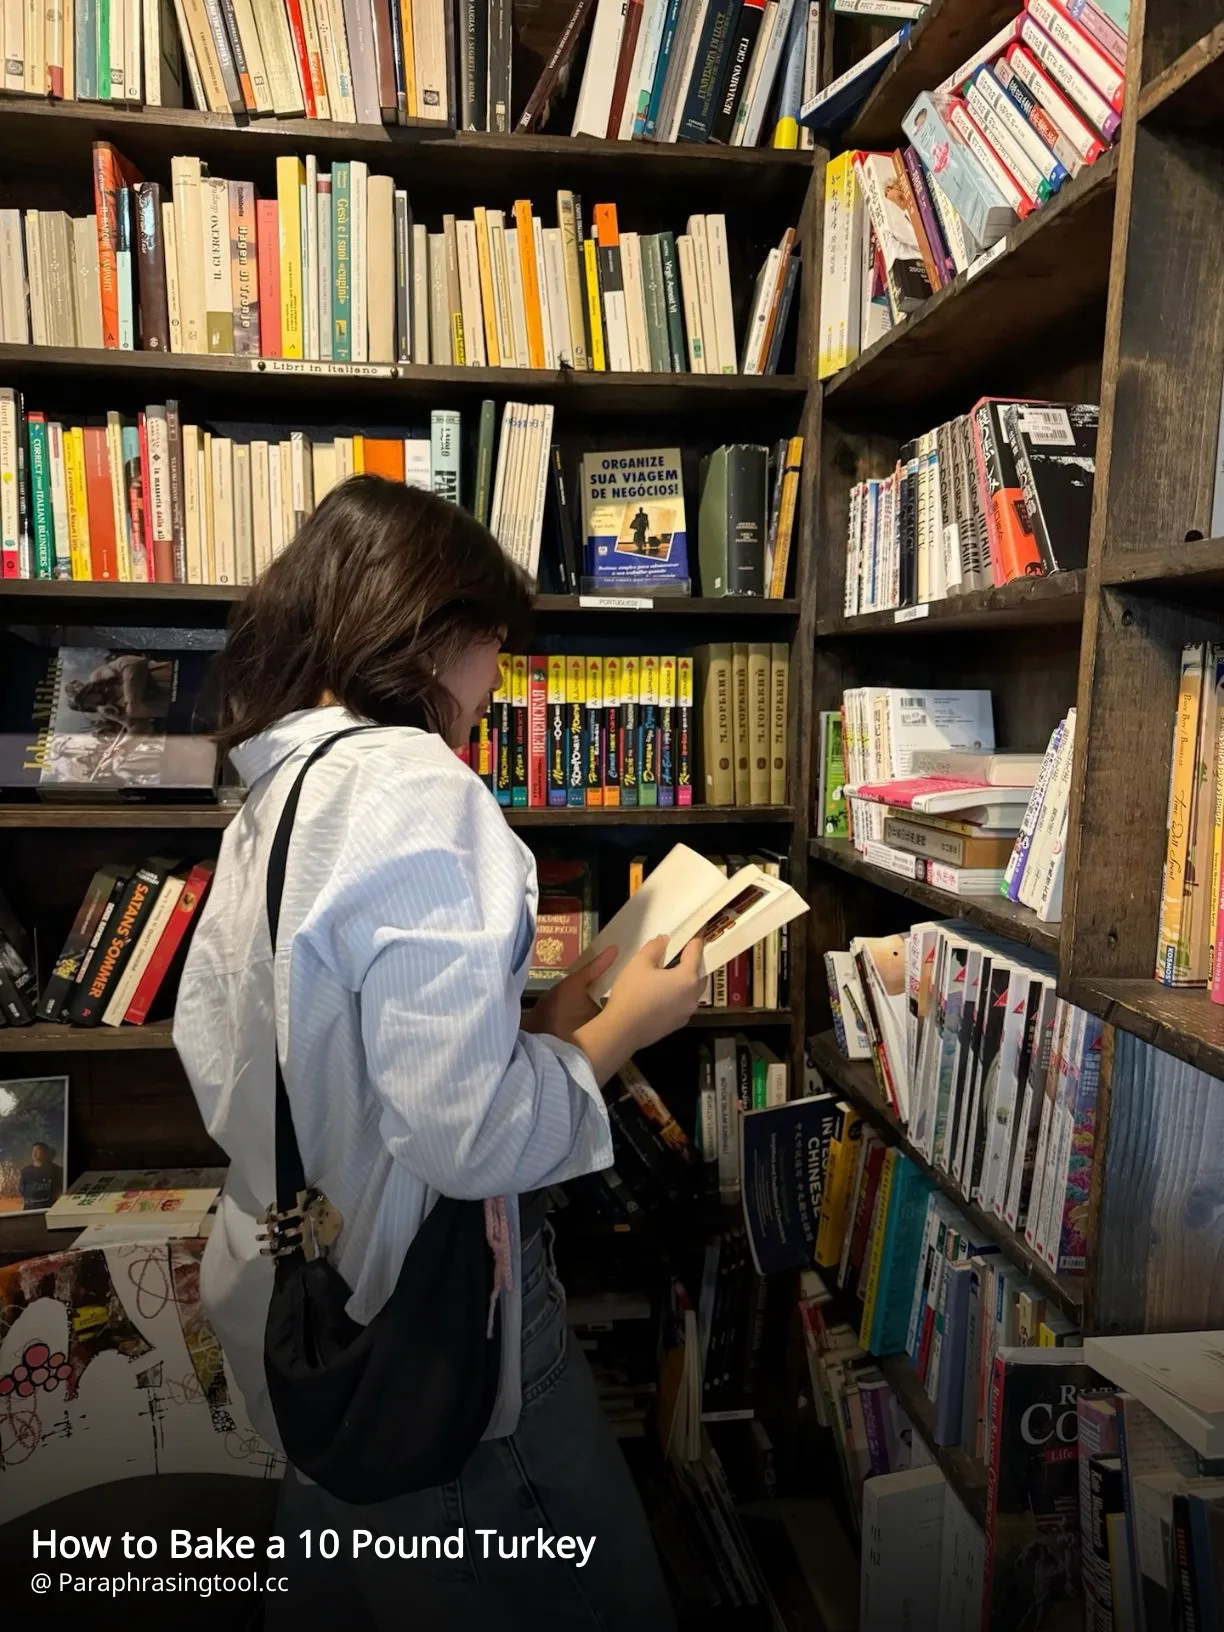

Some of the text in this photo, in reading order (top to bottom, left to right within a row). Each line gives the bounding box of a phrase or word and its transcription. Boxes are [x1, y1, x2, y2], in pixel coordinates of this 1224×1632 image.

[722, 36, 750, 116] BENIAMINO GIGLI
[336, 198, 349, 223] Gesù
[211, 215, 222, 266] GUERCINO
[237, 225, 248, 265] Hagen
[336, 240, 348, 261] suoi
[240, 285, 251, 329] Tronje
[273, 362, 304, 371] Libri
[309, 364, 322, 372] in
[1, 395, 12, 468] Fluent Forever
[33, 438, 43, 475] CORRECT
[601, 456, 664, 470] ORGANIZE
[590, 469, 678, 485] SUA VIAGEM
[591, 483, 678, 499] DE NEGÓCIOS!
[35, 490, 45, 523] ITALIAN
[38, 524, 48, 568] BLUNDERS
[1168, 849, 1182, 881] Spent
[116, 882, 149, 936] SATANS
[88, 937, 125, 999] SOMMER
[1164, 947, 1175, 980] KOSMOS
[807, 1137, 822, 1218] CHINESE
[1051, 1448, 1073, 1460] Life
